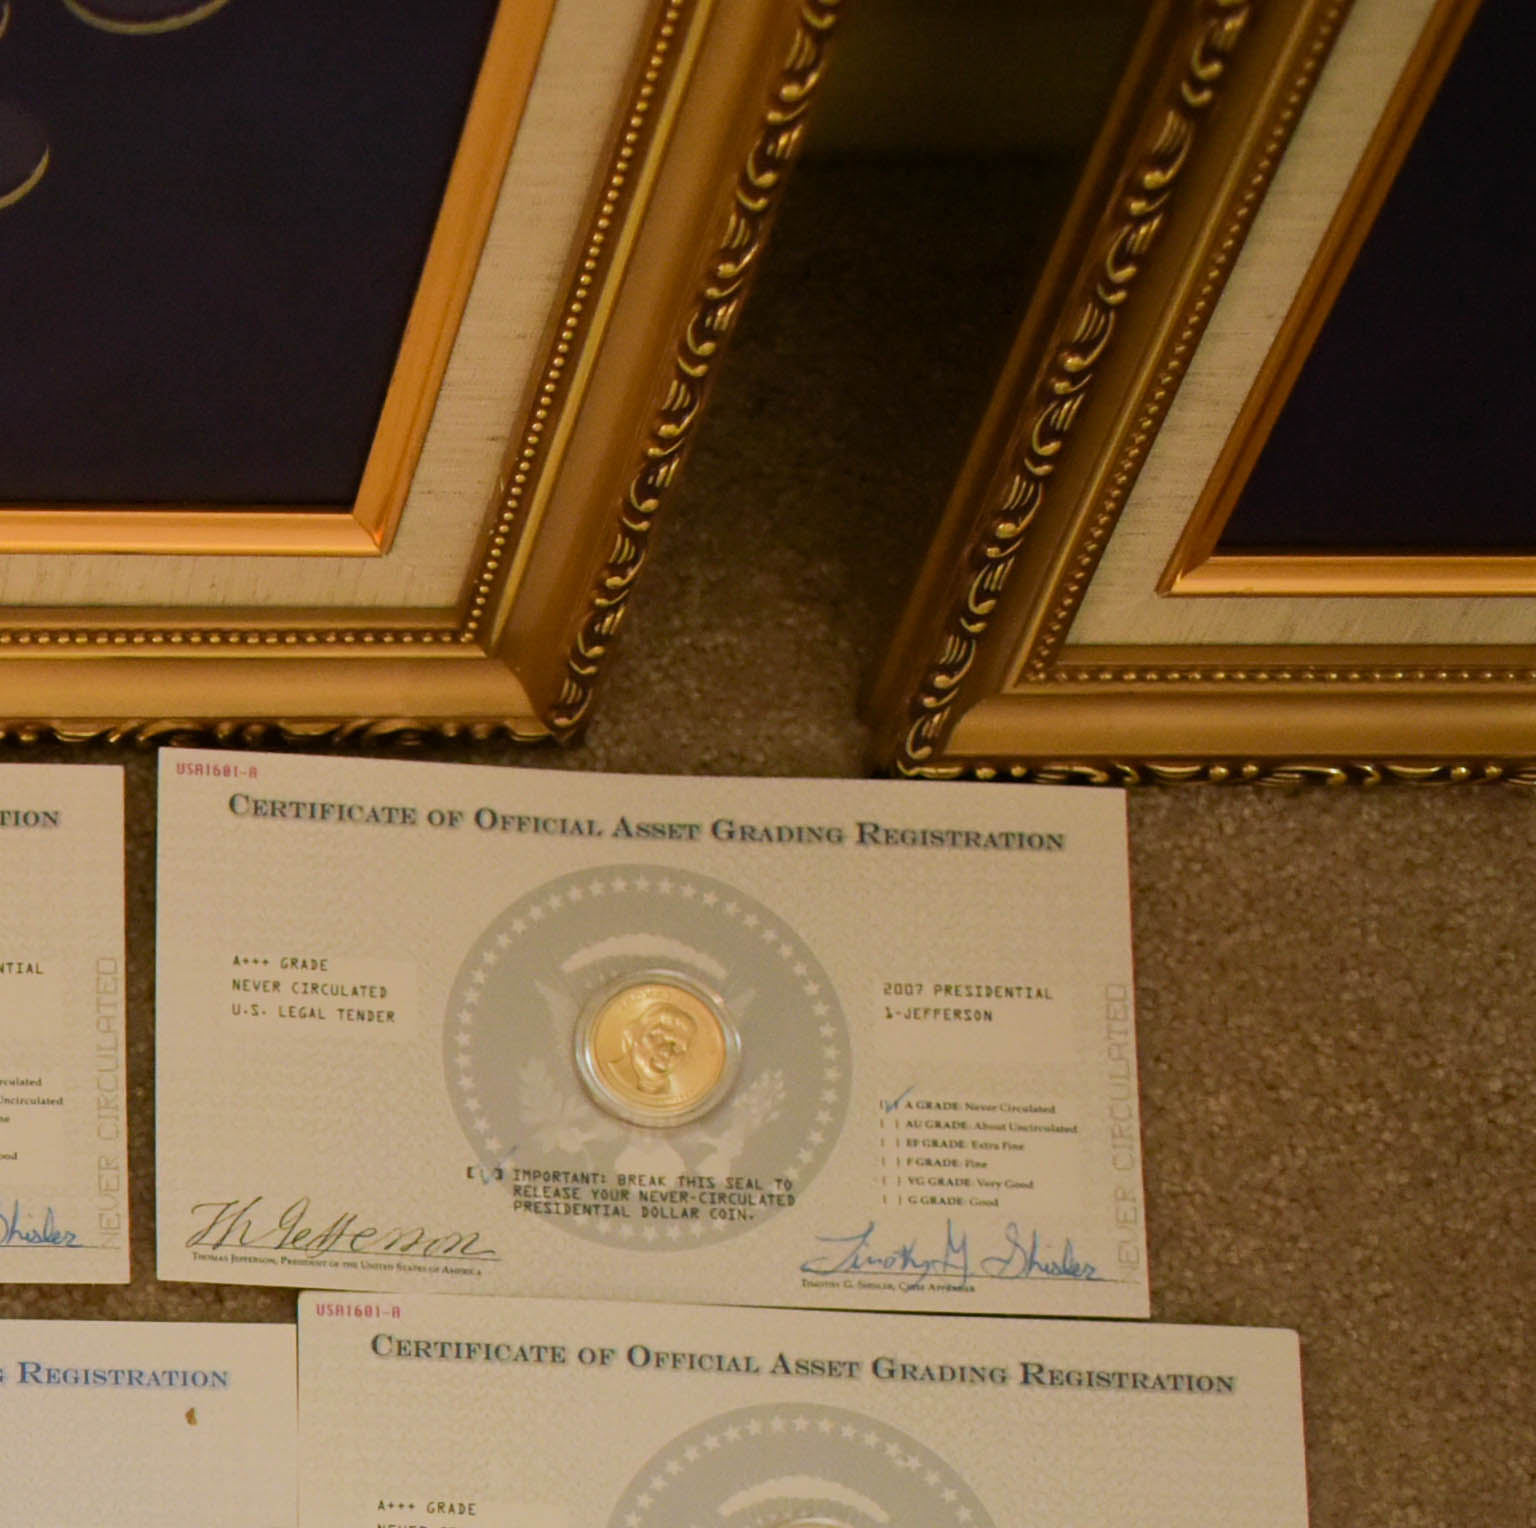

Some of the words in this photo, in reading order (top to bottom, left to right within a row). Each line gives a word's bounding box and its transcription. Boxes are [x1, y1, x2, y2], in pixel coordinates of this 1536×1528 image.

[227, 792, 418, 827] CERTIFICATE
[426, 808, 465, 829] OF
[473, 806, 604, 838] OFFICIAL
[611, 816, 703, 841] ASSET
[709, 817, 845, 845] GRADING
[854, 821, 1065, 852] REGISTRATION
[883, 982, 924, 996] 2007
[933, 983, 1053, 1000] PRESIDENTIAL
[231, 1003, 267, 1017] U.S.
[277, 1004, 326, 1020] LEGAL
[336, 1007, 395, 1024] TENDER
[884, 1005, 993, 1023] 1-JEFFERSON
[16, 1360, 228, 1388] REGISTRATION
[370, 1333, 567, 1368] CERTIFICATE
[577, 1346, 617, 1368] OF
[626, 1343, 760, 1375] OFFICIAL
[768, 1351, 861, 1380] ASSET
[871, 1355, 1008, 1385] GRADING
[1019, 1361, 1235, 1394] REGISTRATION
